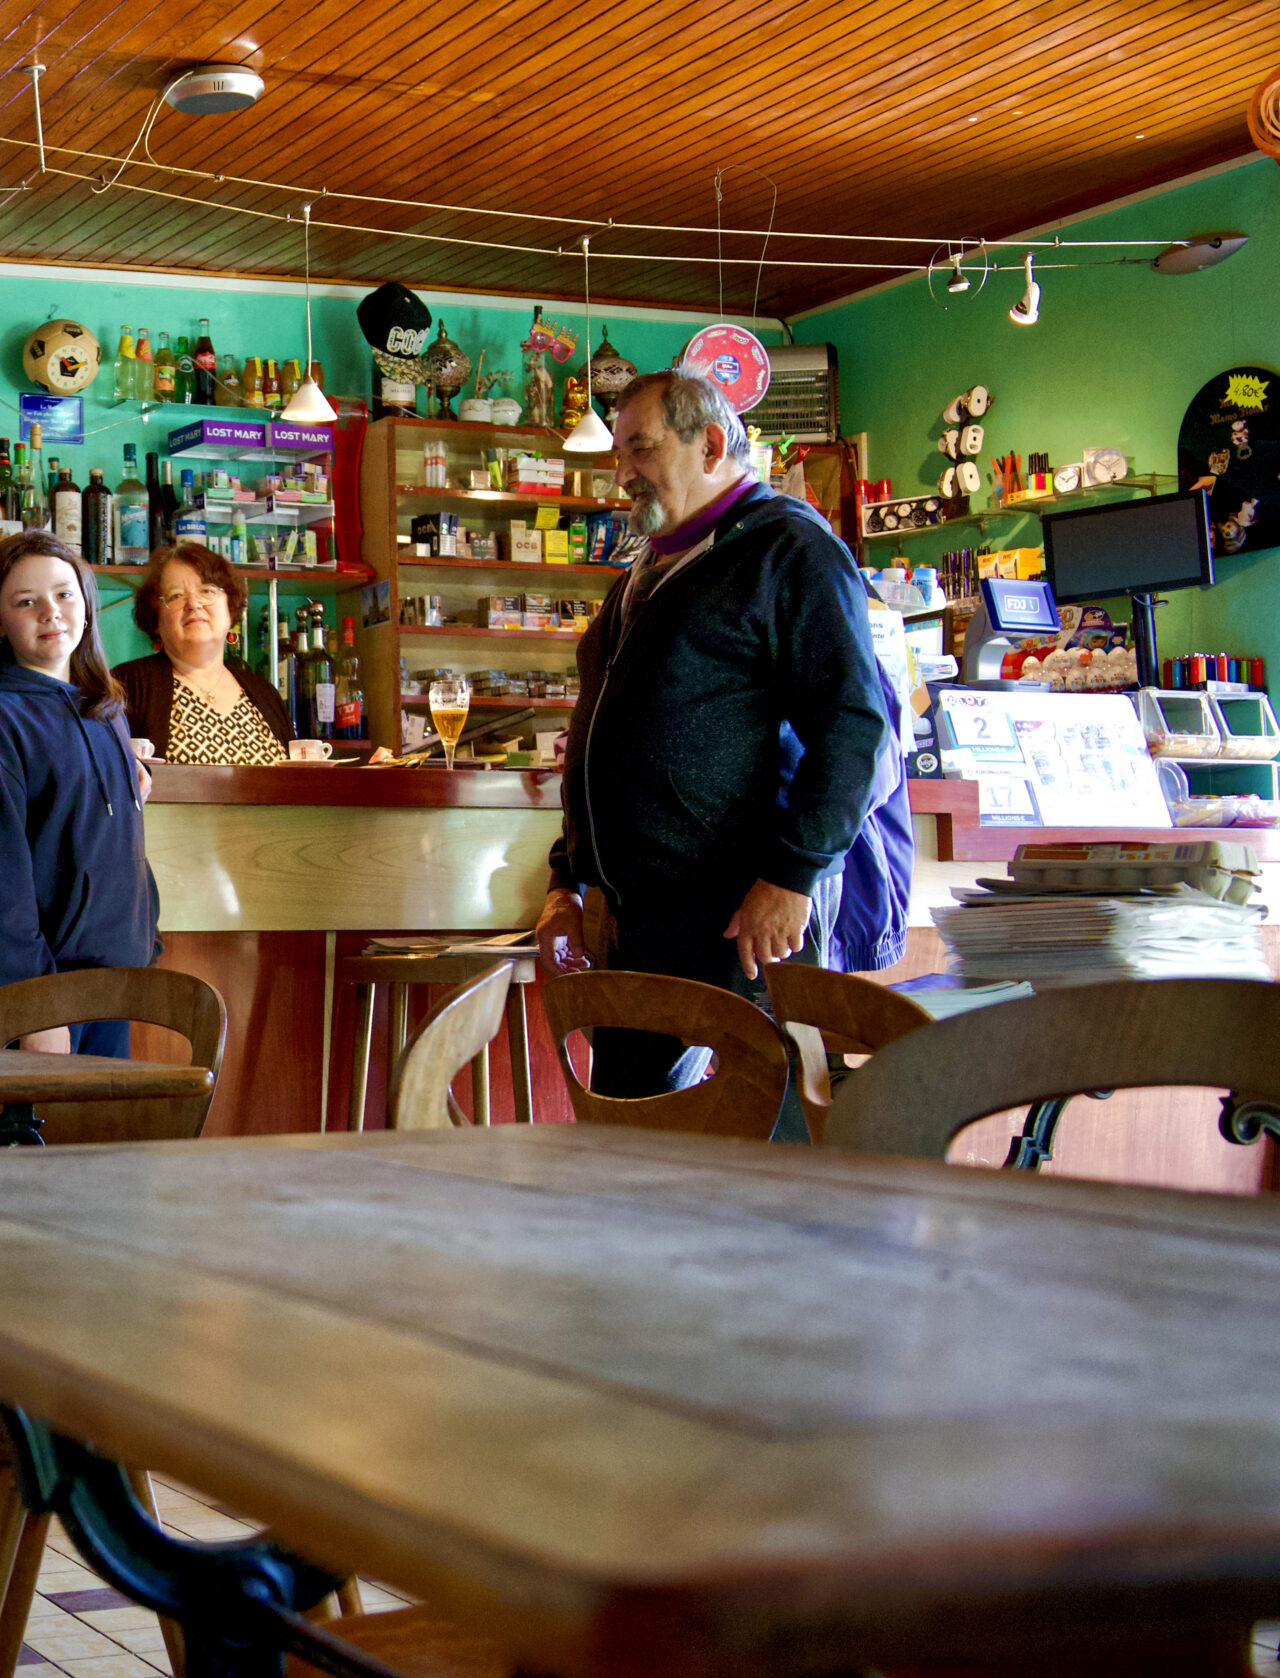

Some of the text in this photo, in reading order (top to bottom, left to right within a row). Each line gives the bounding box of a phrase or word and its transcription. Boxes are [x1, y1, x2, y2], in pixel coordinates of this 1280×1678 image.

[169, 428, 202, 448] LOST MARY
[206, 427, 263, 440] LOST MARY
[274, 430, 330, 442] LOST MARY
[516, 541, 538, 550] OCB
[1007, 599, 1026, 610] FDJ
[974, 717, 992, 738] 2
[986, 786, 1012, 808] 17
